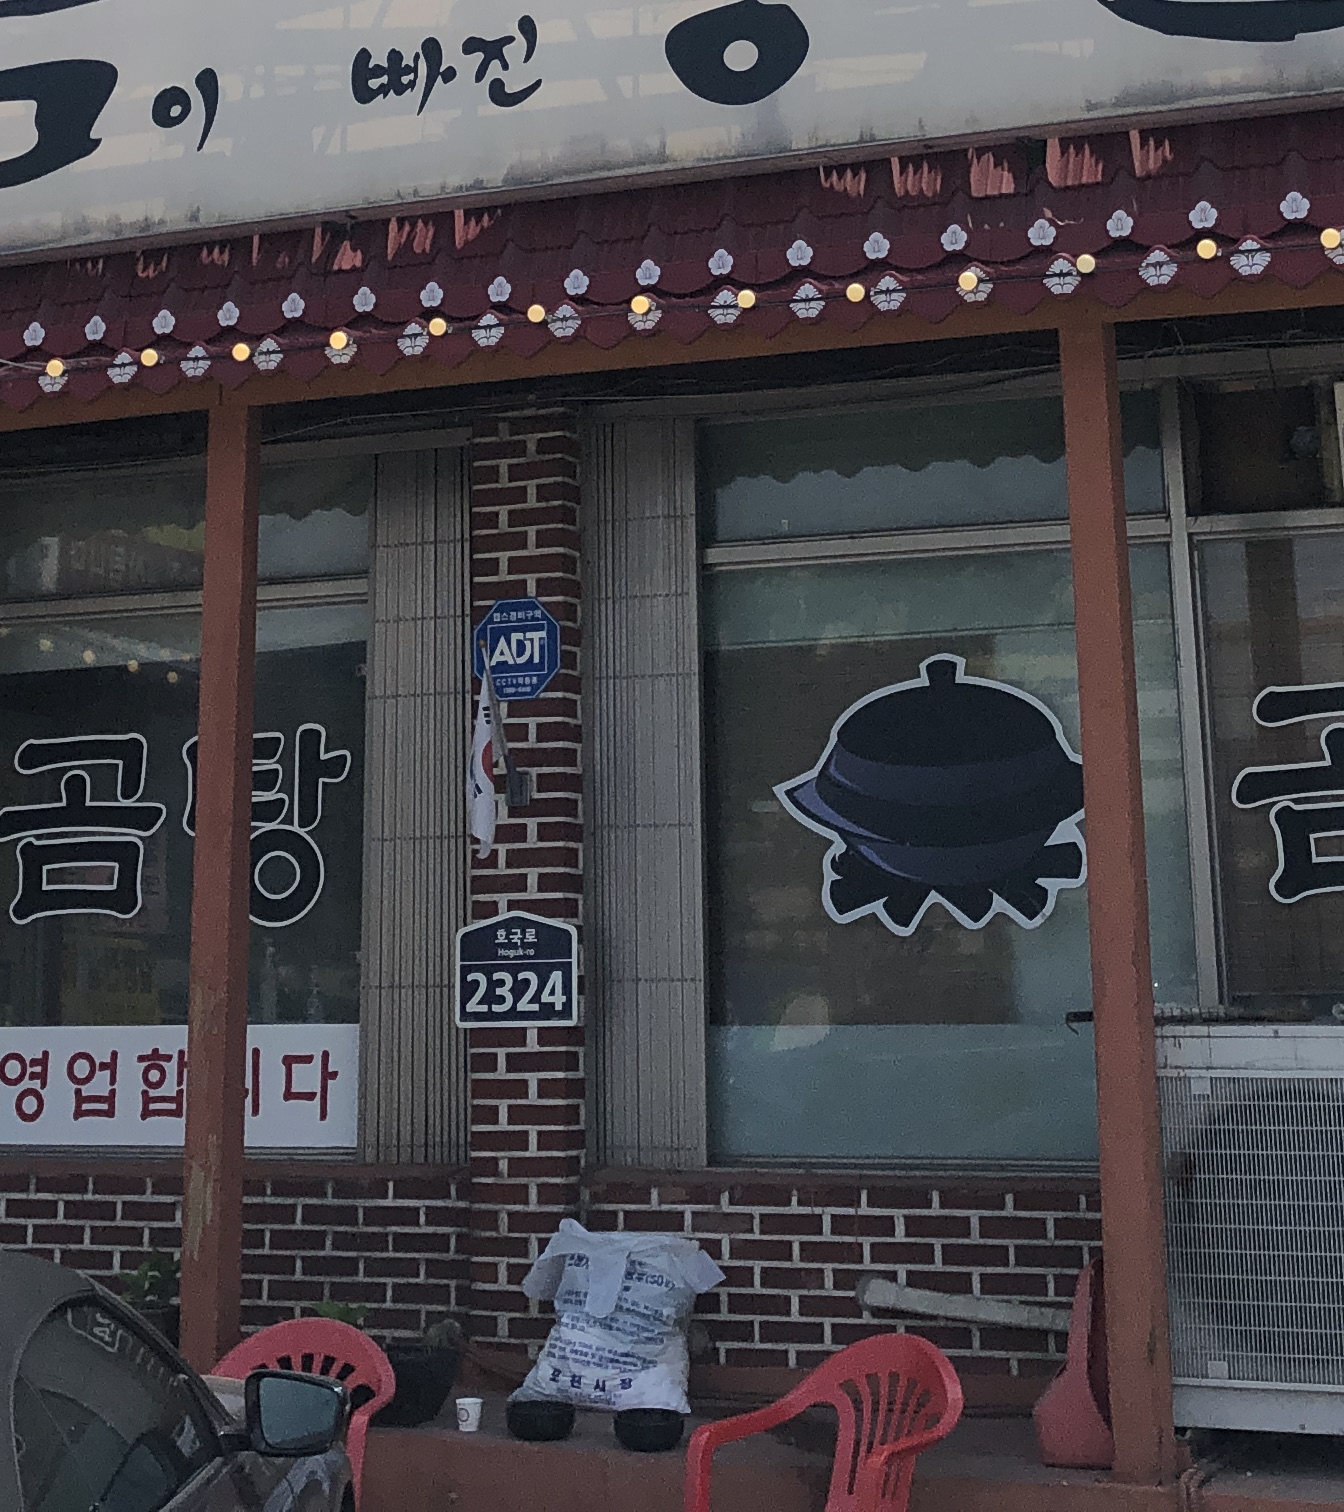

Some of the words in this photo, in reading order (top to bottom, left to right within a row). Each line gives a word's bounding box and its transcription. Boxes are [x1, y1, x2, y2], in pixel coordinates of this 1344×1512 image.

[351, 14, 543, 116] 빠진
[490, 630, 547, 666] ADT
[494, 928, 538, 947] 호국로
[497, 947, 535, 959] Hoguk-ro
[465, 970, 567, 1013] 2324
